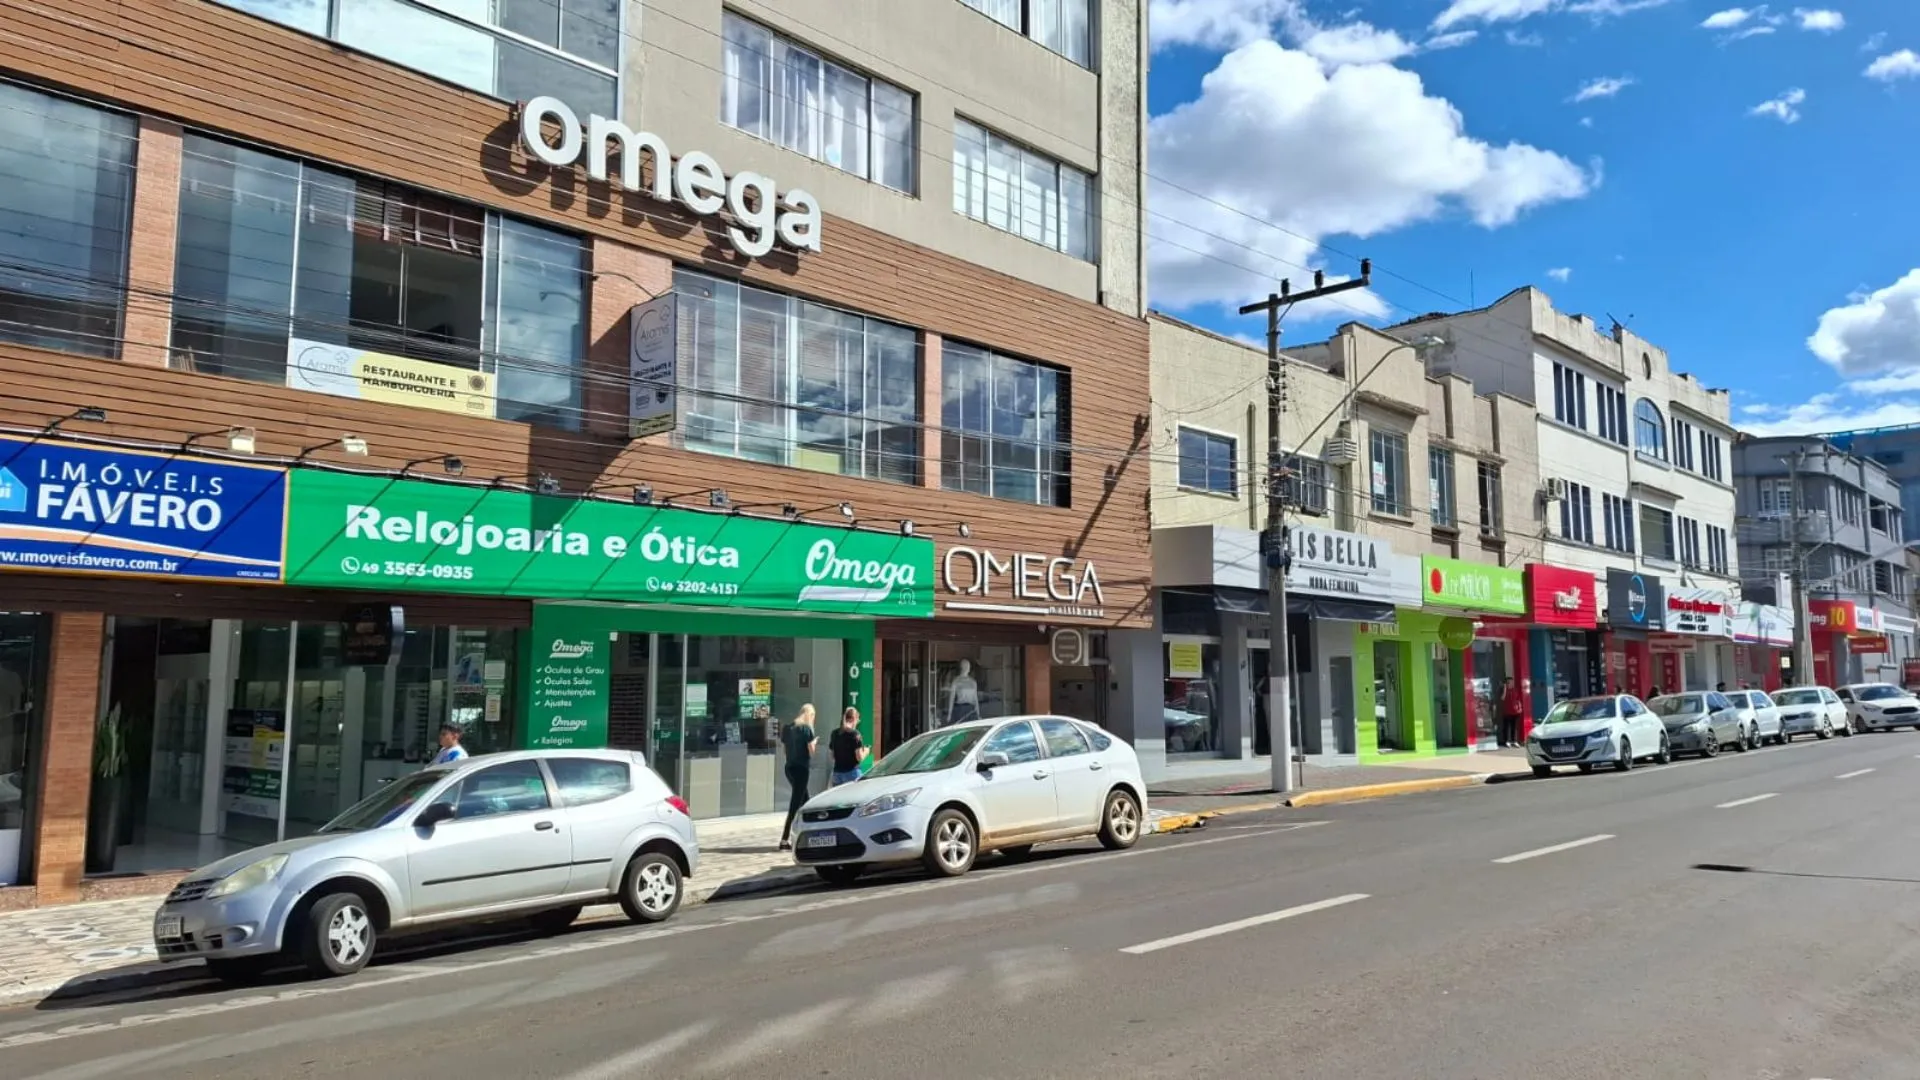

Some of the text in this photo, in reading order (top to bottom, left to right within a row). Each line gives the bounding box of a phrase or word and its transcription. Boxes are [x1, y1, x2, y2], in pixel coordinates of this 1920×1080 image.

[521, 95, 822, 257] omega
[363, 365, 446, 386] RESTAURANTE
[449, 379, 456, 388] E
[363, 378, 456, 398] HAMBURGUERIA
[37, 481, 221, 532] FÁVERO
[345, 504, 739, 569] Relojoaria e Ótica
[1324, 535, 1377, 569] BELLA
[361, 561, 474, 580] 49 3563-0935
[802, 538, 916, 594] Omega
[943, 546, 1104, 605] OMEGA
[676, 580, 738, 595] 3202-4151
[1309, 575, 1359, 594] MODA FEMININA
[1829, 606, 1846, 627] 10
[551, 639, 594, 656] Omega
[544, 664, 604, 674] Óculos de Grau
[544, 676, 571, 685] Óculos
[545, 688, 596, 697] Manutenções
[544, 699, 572, 708] Ajustes
